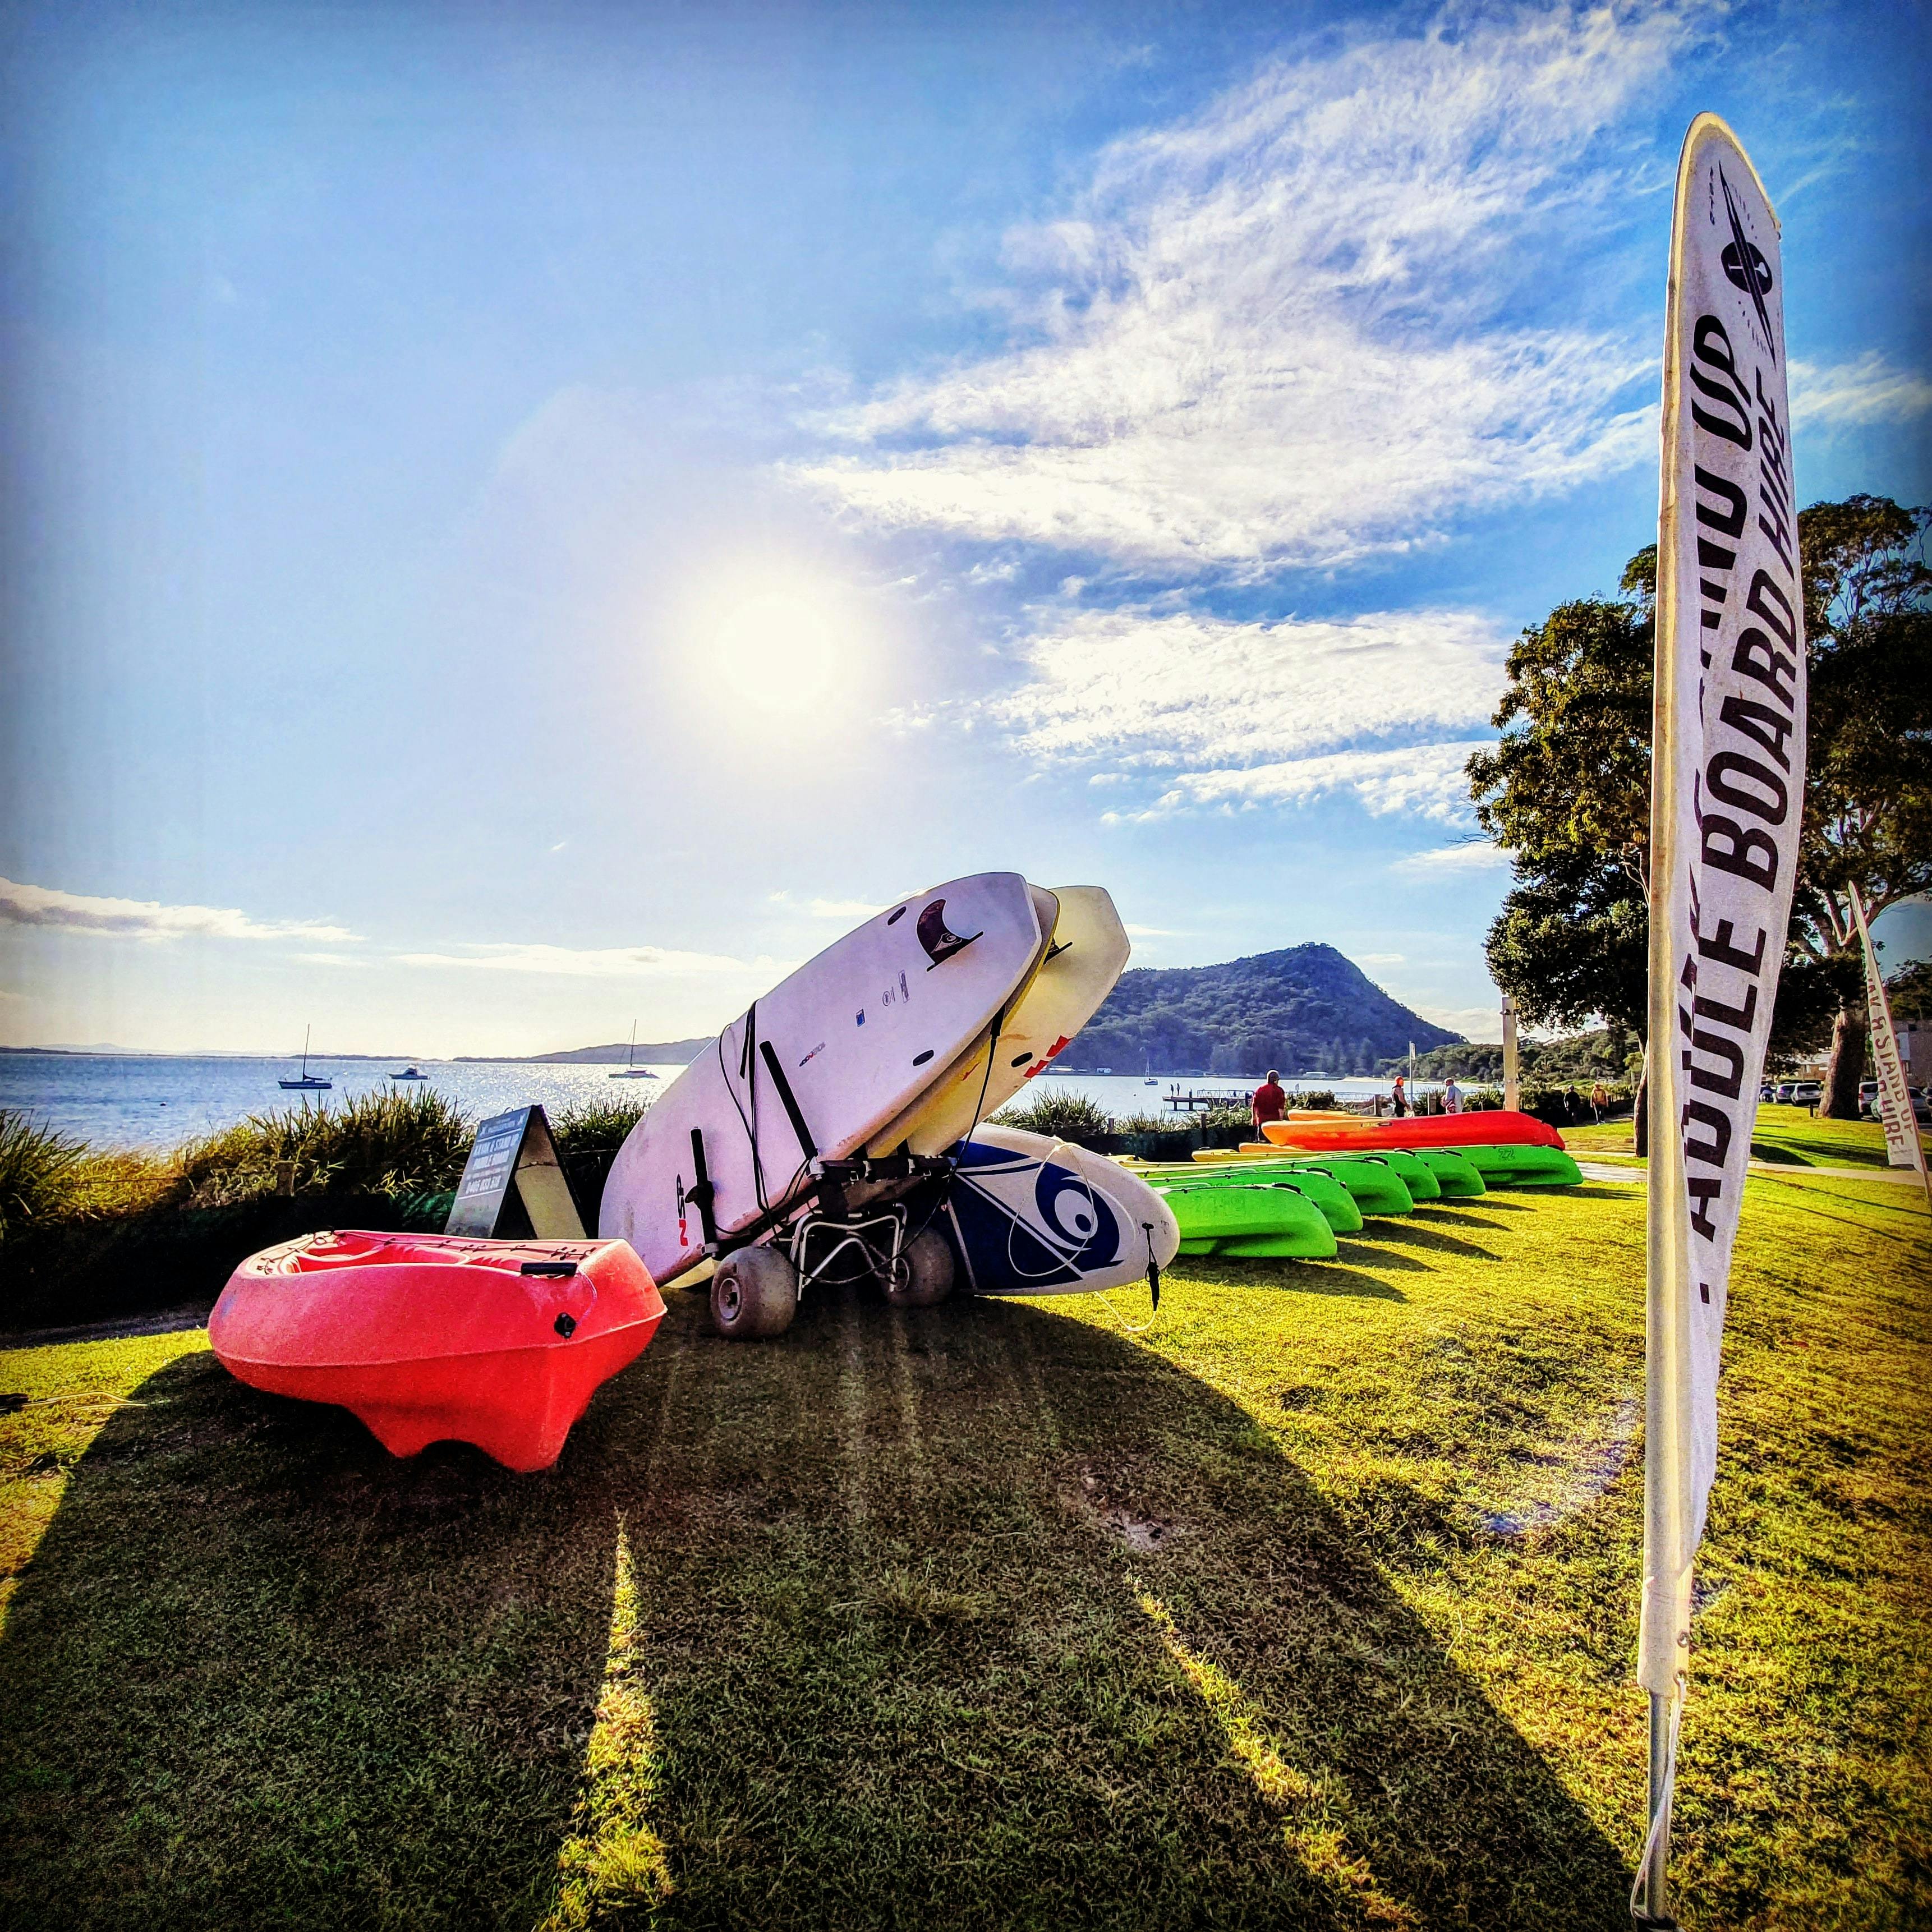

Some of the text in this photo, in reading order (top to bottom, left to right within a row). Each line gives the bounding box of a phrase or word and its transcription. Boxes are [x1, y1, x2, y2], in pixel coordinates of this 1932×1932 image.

[1690, 314, 1752, 452] UP
[1701, 568, 1797, 893] BOARD
[1755, 365, 1795, 581] HIRE
[1875, 1034, 1906, 1103] STAND
[677, 1174, 688, 1246] NSP
